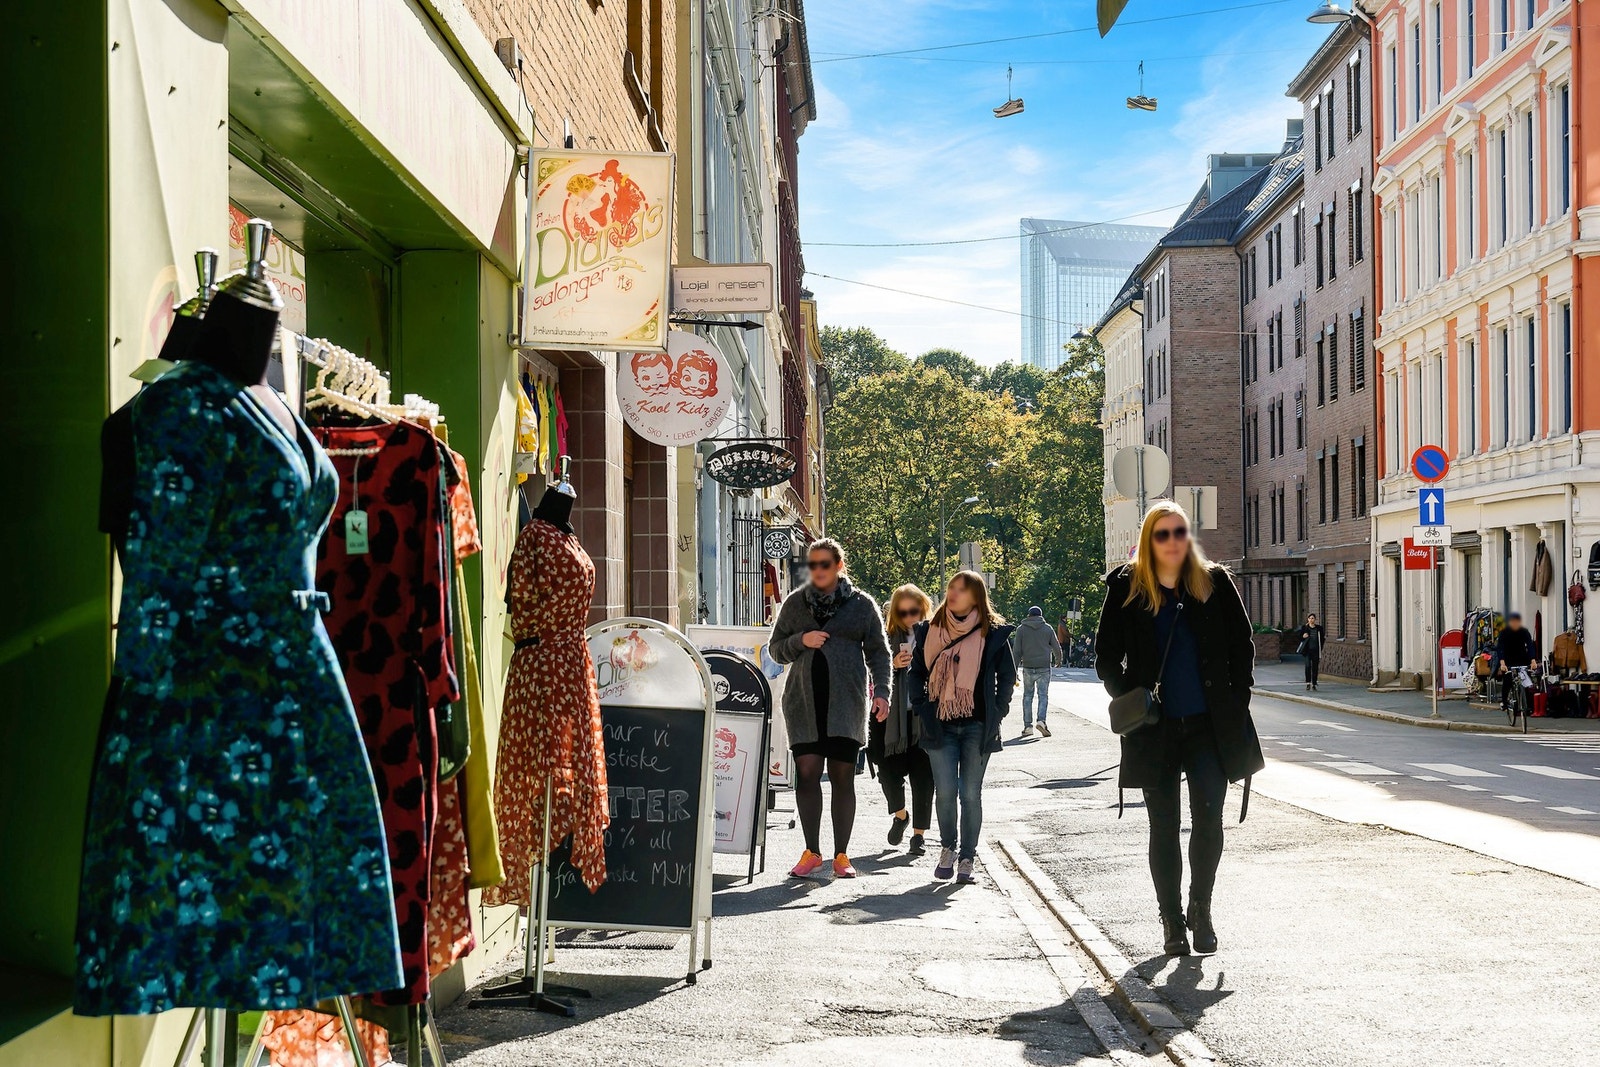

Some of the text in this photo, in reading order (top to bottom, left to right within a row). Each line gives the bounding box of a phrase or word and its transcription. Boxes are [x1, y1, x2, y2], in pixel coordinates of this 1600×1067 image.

[533, 203, 664, 290] Dianas
[533, 266, 611, 312] salonger
[680, 279, 766, 291] Lojal renseri
[624, 402, 725, 441] KLÆR SKO LEKER GAVER
[636, 399, 711, 419] Kool Kidz
[731, 690, 760, 707] Kidz
[653, 723, 671, 747] vi
[605, 747, 672, 772] stiske
[607, 786, 691, 823] TTER
[650, 829, 672, 850] ull
[554, 861, 577, 899] fra
